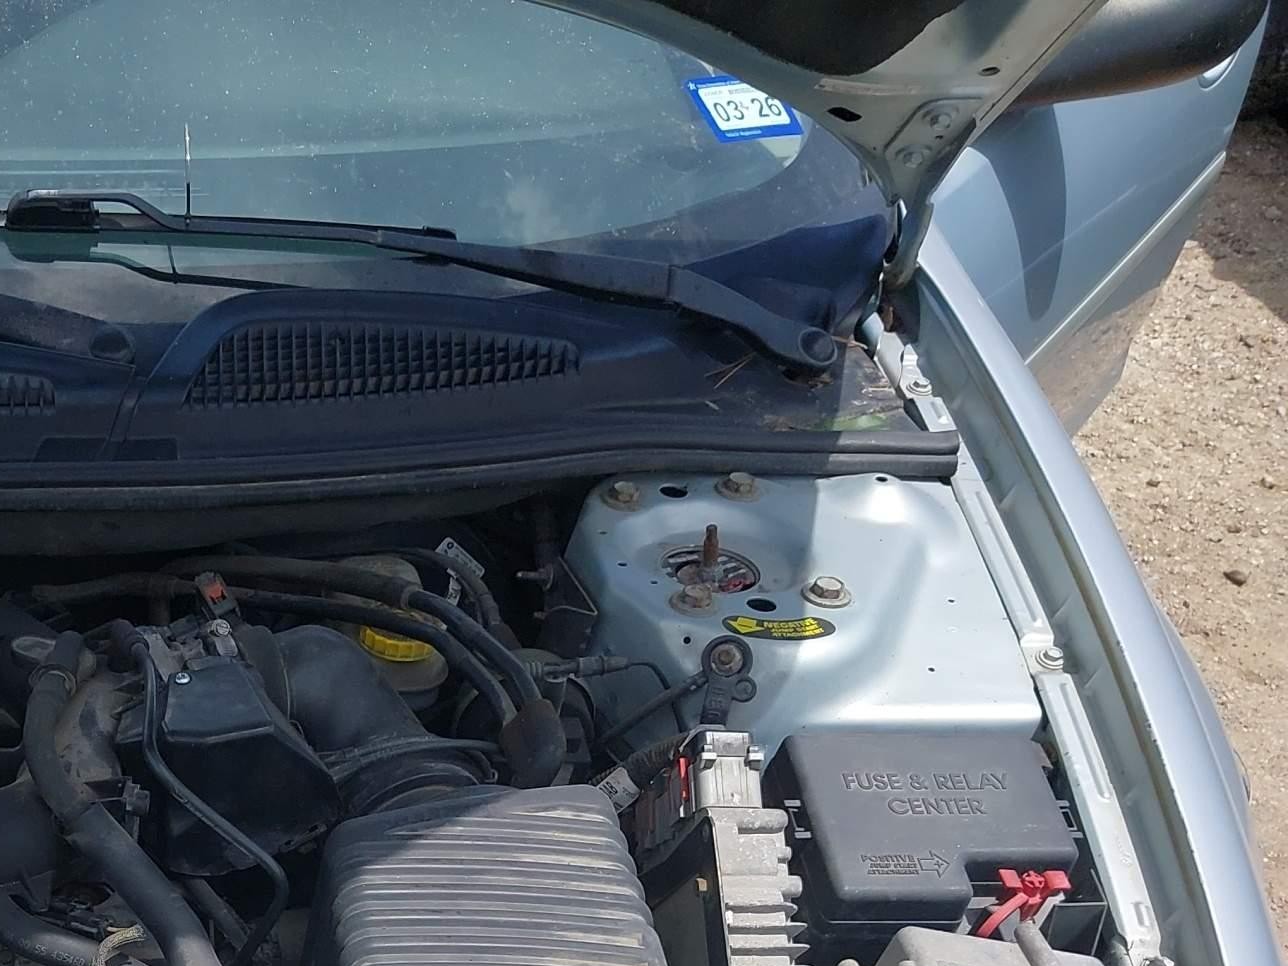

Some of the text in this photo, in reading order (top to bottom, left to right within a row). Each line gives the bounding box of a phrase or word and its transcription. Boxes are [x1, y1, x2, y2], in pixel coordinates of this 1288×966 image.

[713, 97, 782, 122] 03 26
[842, 772, 1008, 791] FUSE & RELAY
[888, 797, 988, 815] CENTER
